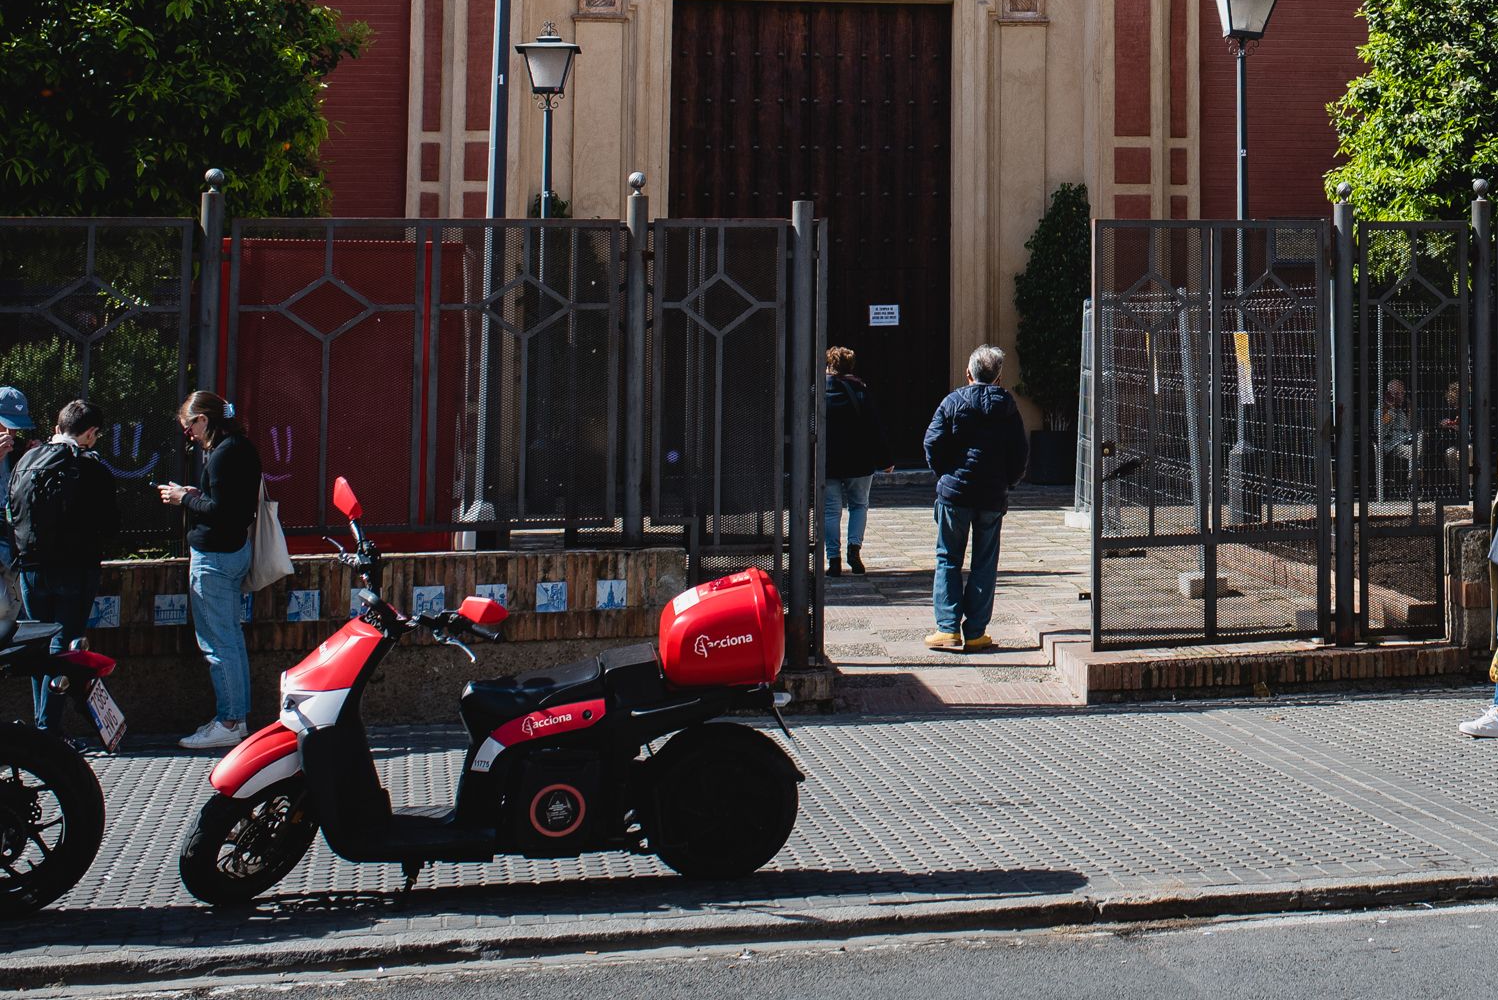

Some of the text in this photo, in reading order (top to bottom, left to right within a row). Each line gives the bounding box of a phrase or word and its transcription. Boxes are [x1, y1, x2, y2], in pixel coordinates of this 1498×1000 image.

[707, 633, 753, 649] acciona
[532, 713, 572, 729] acciona
[474, 759, 490, 768] 11775
